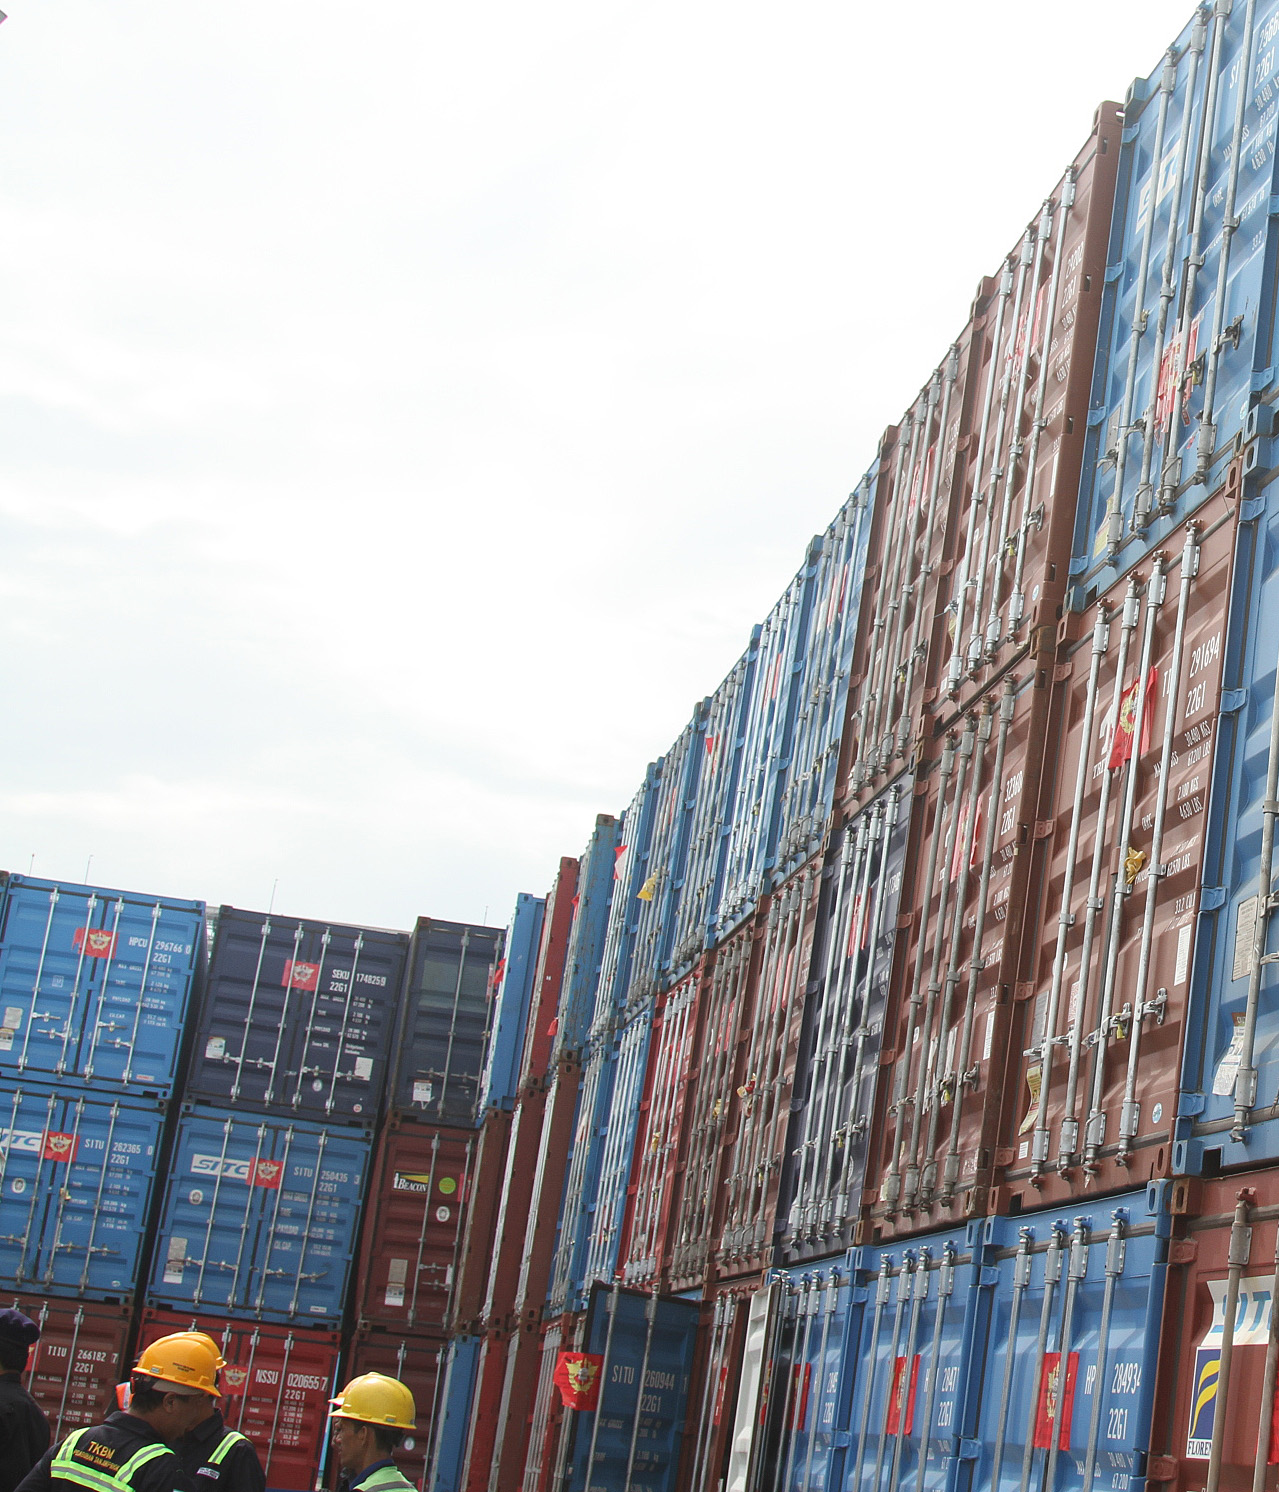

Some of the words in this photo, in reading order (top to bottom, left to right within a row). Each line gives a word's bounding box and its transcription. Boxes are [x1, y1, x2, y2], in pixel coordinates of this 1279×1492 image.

[1254, 46, 1275, 89] 22G1
[1189, 632, 1220, 678] 291694
[1185, 681, 1206, 719] 22G1
[128, 936, 149, 948] HPCU
[155, 940, 183, 953] 296766
[153, 952, 171, 964] 22G1
[332, 969, 350, 980] SEKU
[329, 981, 347, 993] 22G1
[84, 1138, 105, 1150] SITU
[113, 1142, 141, 1154] 262365
[110, 1154, 130, 1165] 22G1
[193, 1159, 250, 1176] SITC
[293, 1166, 313, 1178] SITU
[321, 1170, 348, 1183] 250435
[319, 1182, 337, 1193] 22G1
[77, 1349, 106, 1362] 266182
[74, 1362, 94, 1373] 22G1
[612, 1365, 635, 1385] SITU
[255, 1369, 279, 1384] NSSU
[287, 1373, 320, 1390] 020655
[285, 1389, 306, 1400] 22G1
[641, 1394, 662, 1414] 22G1
[1107, 1408, 1128, 1440] 22G1
[1187, 1440, 1212, 1457] FLOREN
